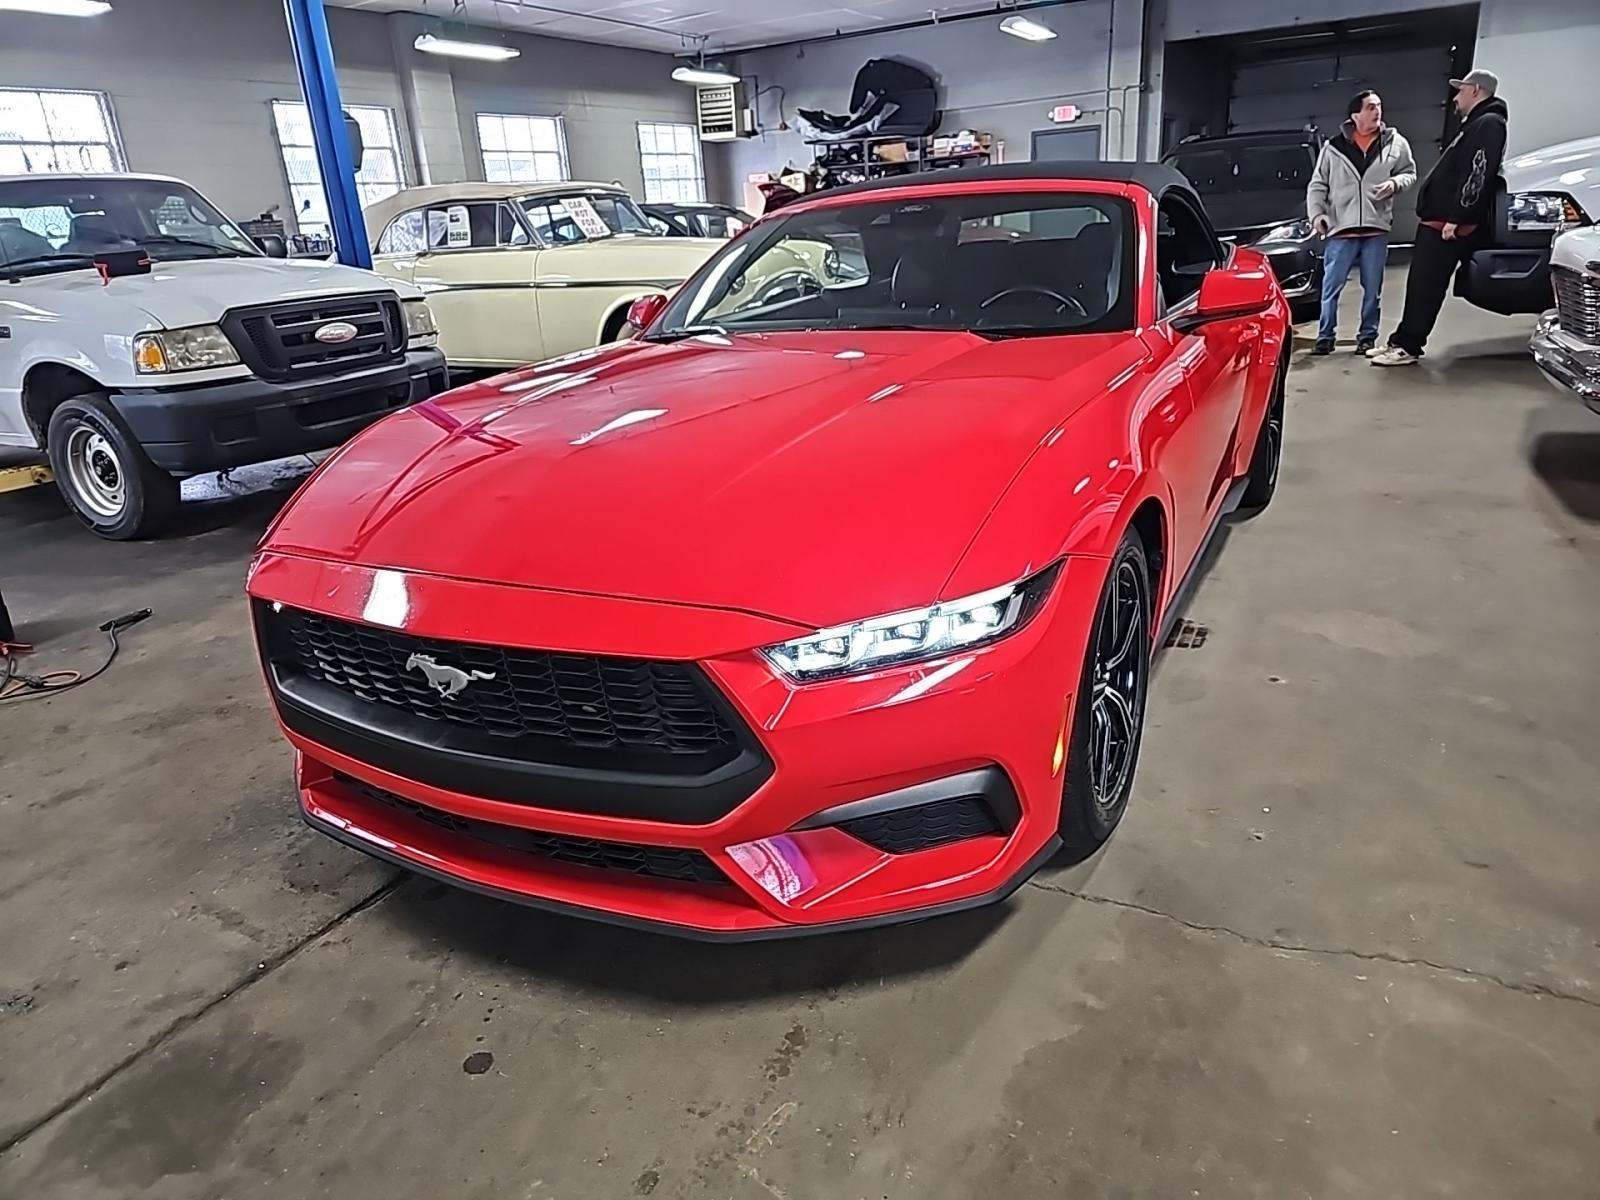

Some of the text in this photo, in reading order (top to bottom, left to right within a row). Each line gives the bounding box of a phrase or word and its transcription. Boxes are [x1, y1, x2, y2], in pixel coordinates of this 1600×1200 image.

[568, 200, 584, 209] CAR
[574, 209, 589, 217] NOT
[581, 218, 596, 226] FOR
[585, 226, 606, 236] SALE
